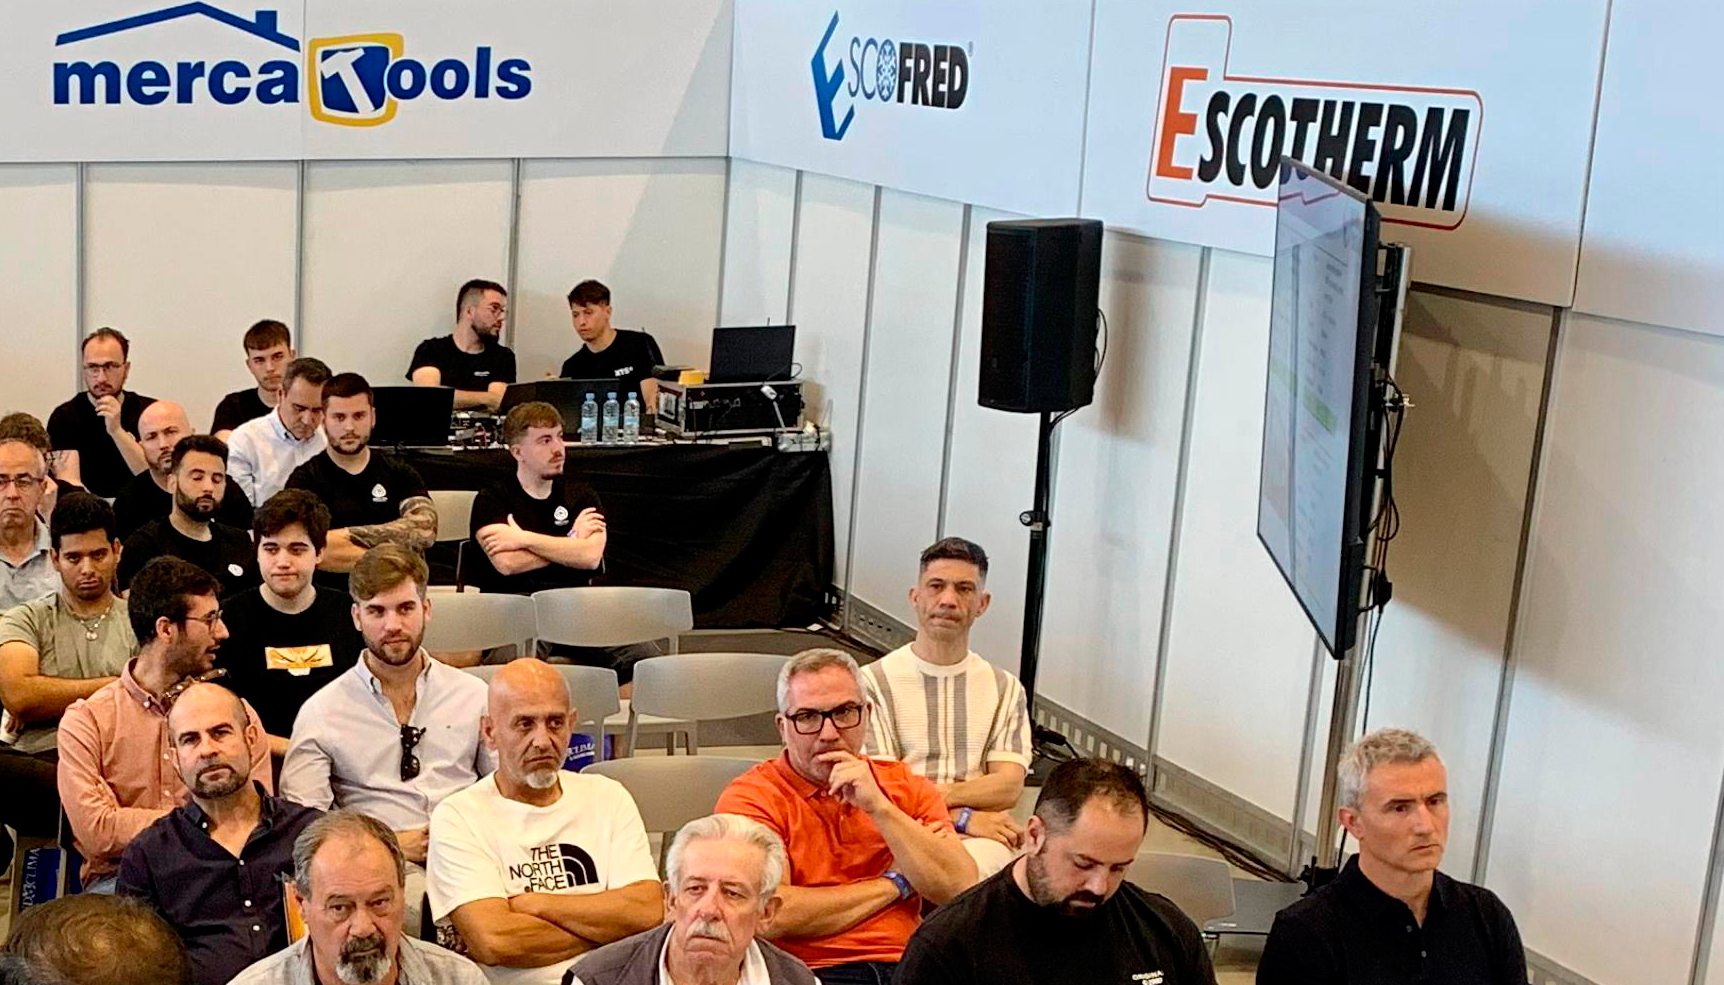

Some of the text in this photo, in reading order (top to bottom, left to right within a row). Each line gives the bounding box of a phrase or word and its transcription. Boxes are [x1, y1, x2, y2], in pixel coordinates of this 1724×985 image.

[1156, 66, 1471, 212] ESCOTHERM
[530, 844, 559, 861] THE
[509, 859, 563, 880] NORTH
[529, 874, 567, 893] FACE
